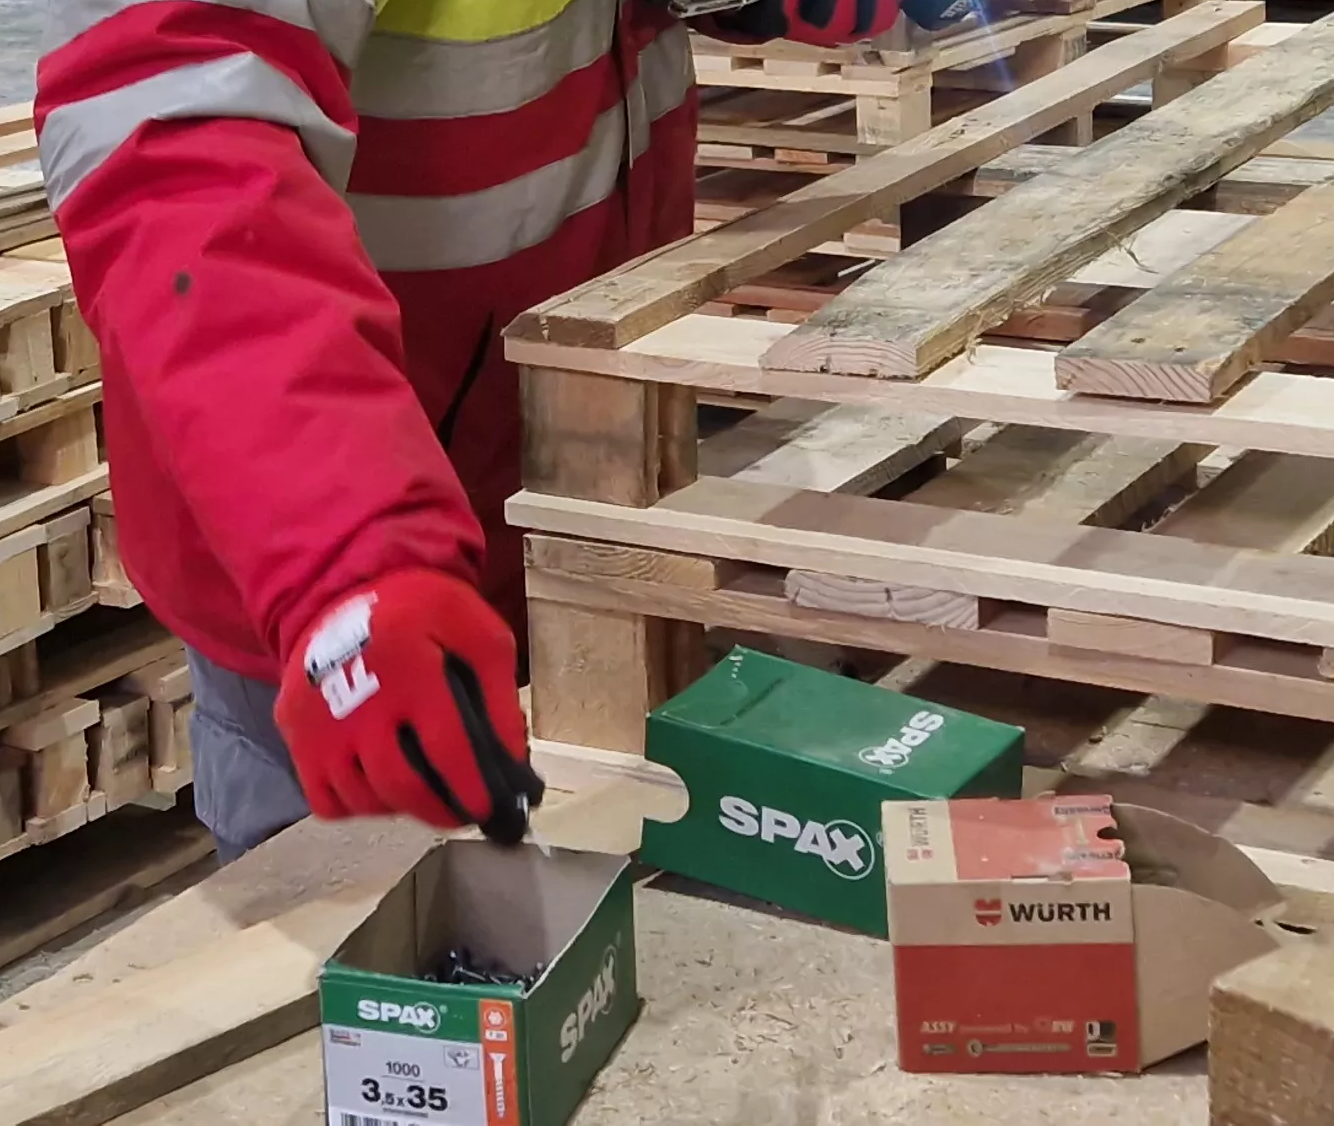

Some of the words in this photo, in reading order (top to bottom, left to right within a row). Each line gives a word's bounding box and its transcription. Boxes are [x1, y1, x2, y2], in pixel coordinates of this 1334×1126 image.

[863, 710, 945, 767] SPAX
[718, 796, 869, 876] SPAX
[1009, 901, 1112, 924] WÜRTH
[356, 999, 437, 1030] SPAX
[559, 944, 617, 1064] SPAX
[385, 1060, 421, 1078] 1000
